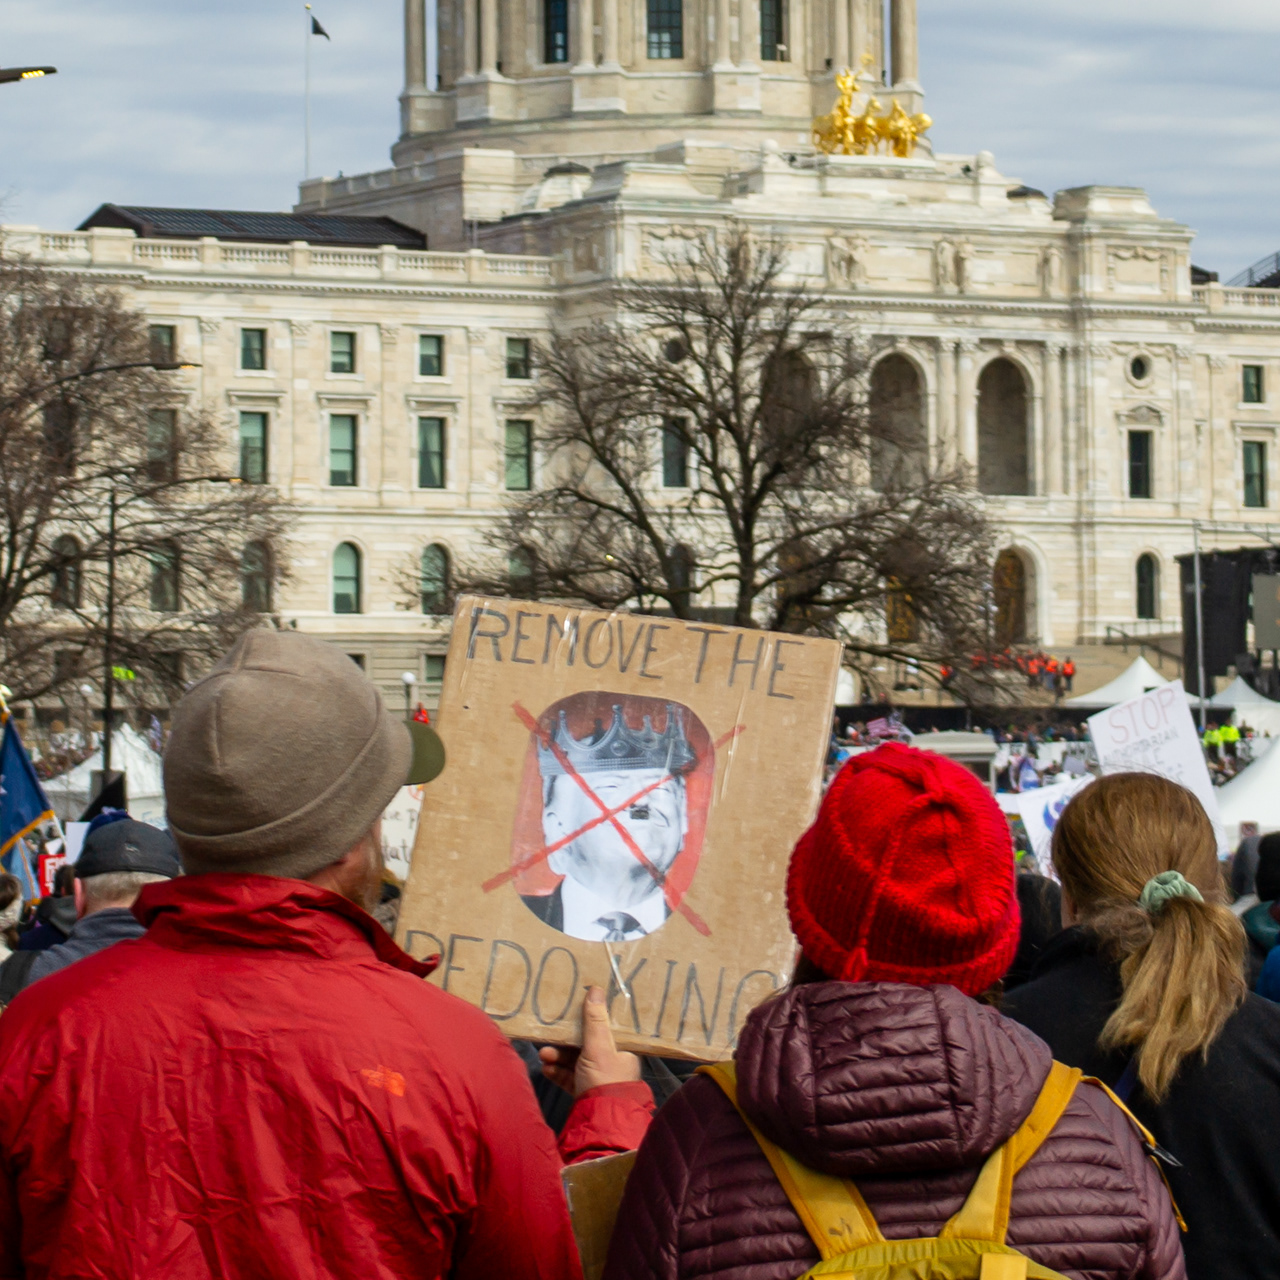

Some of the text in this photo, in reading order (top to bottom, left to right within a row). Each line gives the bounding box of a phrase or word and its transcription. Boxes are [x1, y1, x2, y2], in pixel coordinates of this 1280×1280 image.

[465, 607, 806, 700] REMOVE THE
[1108, 687, 1176, 745] STOP
